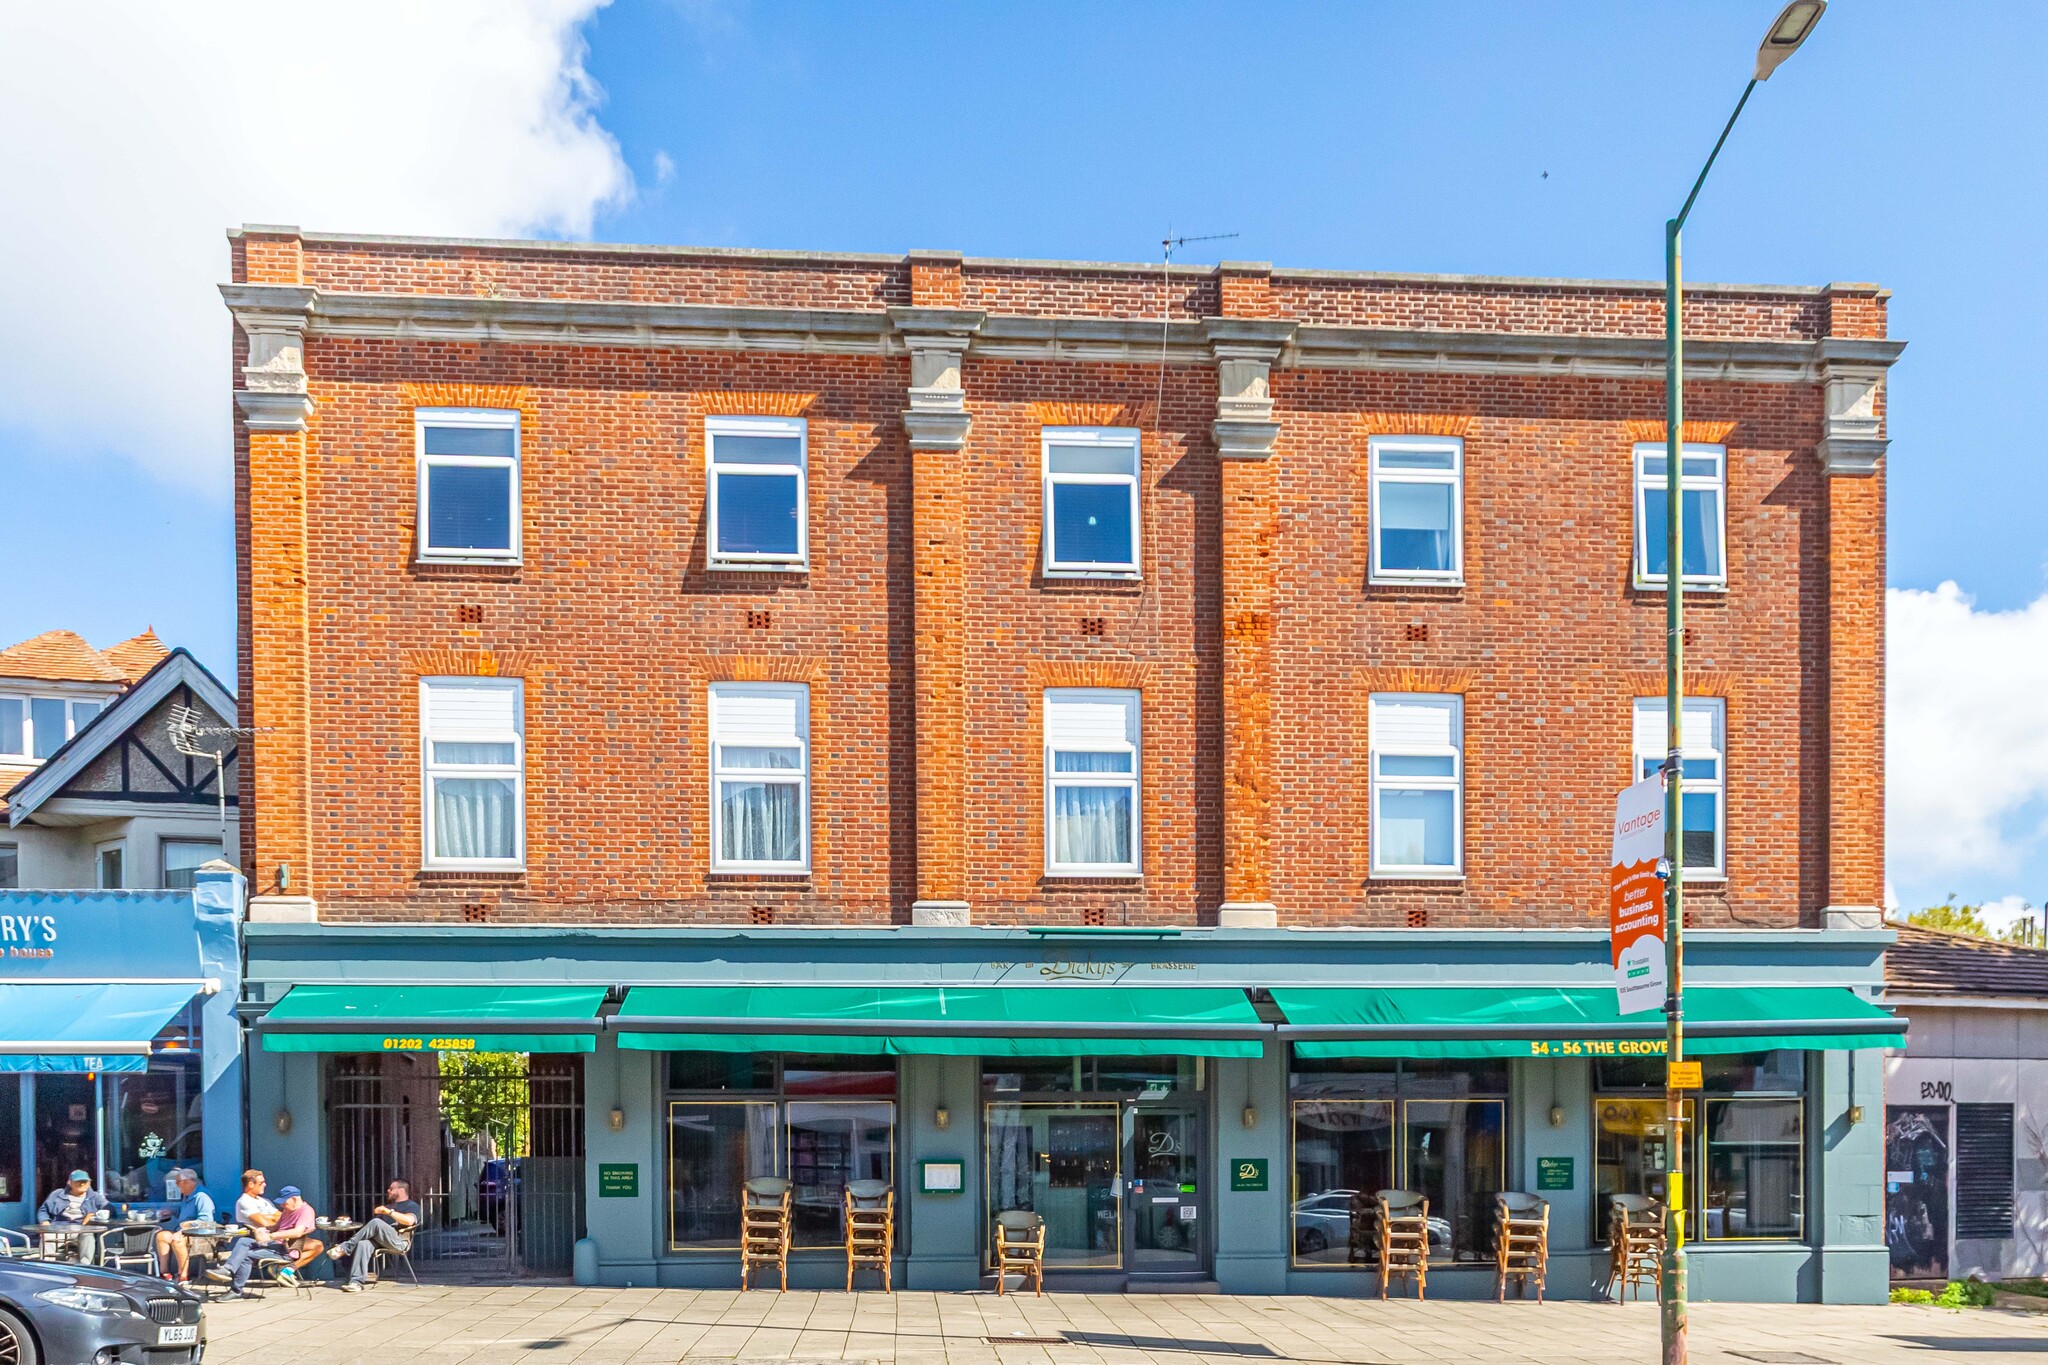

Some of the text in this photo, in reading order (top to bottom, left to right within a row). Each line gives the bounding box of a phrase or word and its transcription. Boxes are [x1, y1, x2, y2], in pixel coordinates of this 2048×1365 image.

[1618, 809, 1661, 835] Vantage
[1623, 887, 1648, 902] better
[1618, 900, 1653, 918] business
[1615, 914, 1659, 934] accounting
[10, 946, 54, 958] house
[1151, 962, 1196, 970] BRASSERIE
[383, 1038, 475, 1049] 01202 425858
[1531, 1042, 1549, 1055] 54
[1562, 1041, 1582, 1055] 56
[1584, 1041, 1615, 1054] THE
[1618, 1040, 1668, 1054] GROVE
[83, 1057, 103, 1070] TEA
[164, 1328, 182, 1341] YL65
